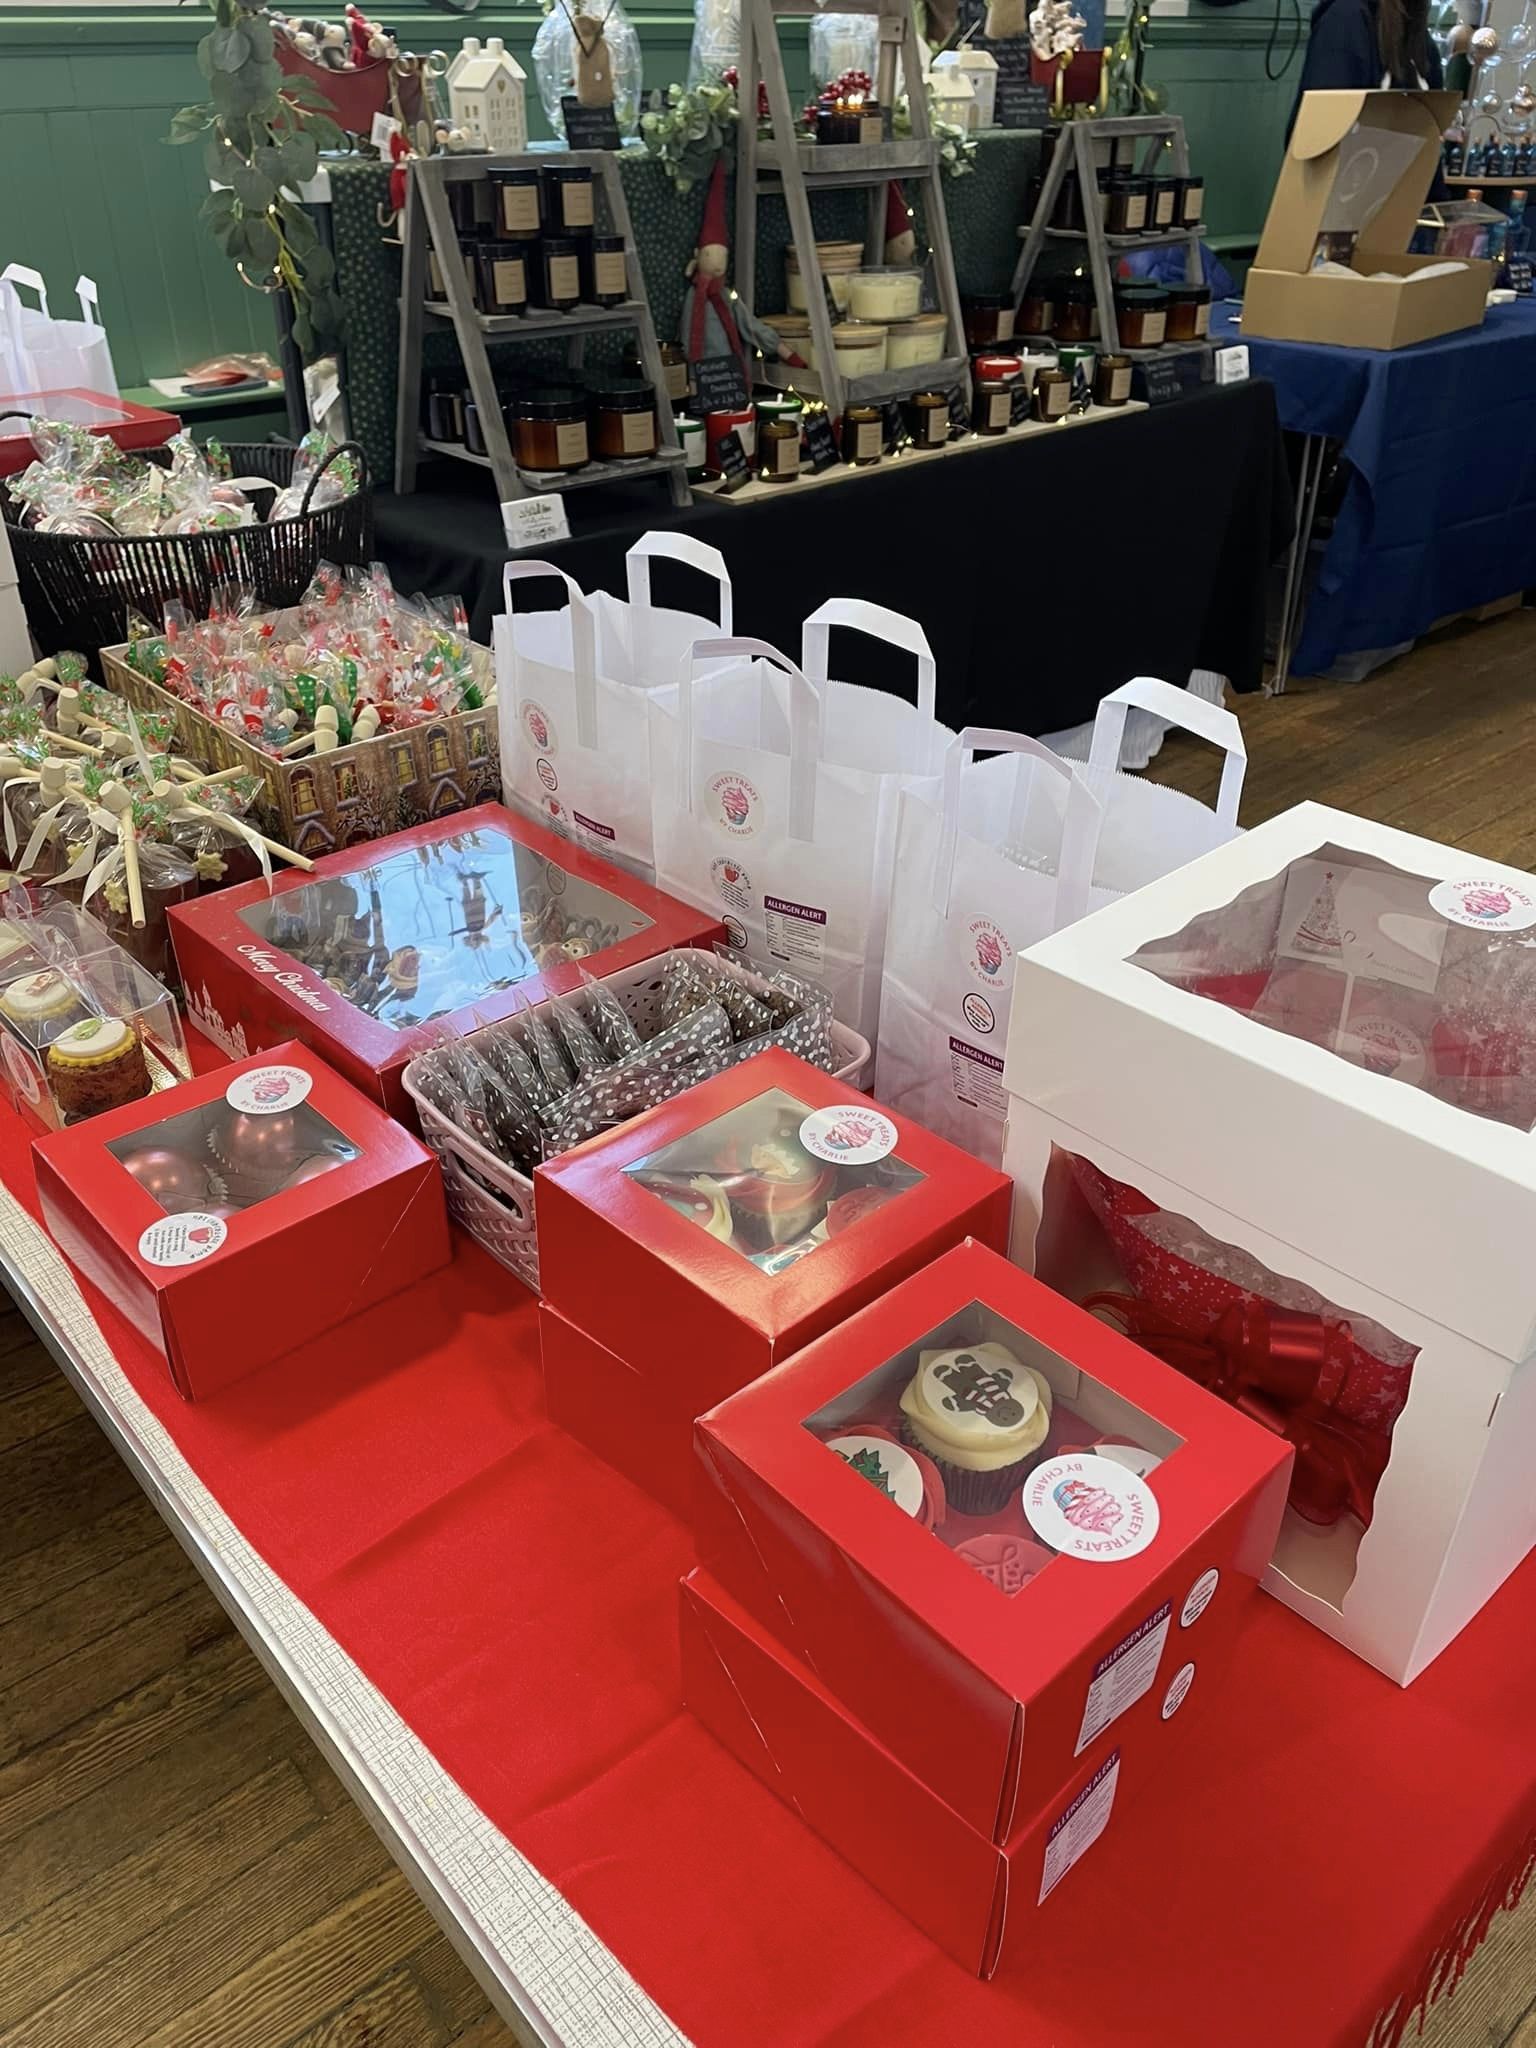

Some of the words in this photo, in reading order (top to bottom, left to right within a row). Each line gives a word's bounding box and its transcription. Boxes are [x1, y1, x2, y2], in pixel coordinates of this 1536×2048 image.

[711, 776, 733, 792] SWEET
[735, 777, 758, 801] TREATS
[1452, 880, 1496, 890] SWEET
[1499, 884, 1533, 907] TREATS
[767, 899, 801, 915] ALLERGEN
[801, 909, 823, 920] ALERT
[969, 920, 991, 933] SWEET
[991, 925, 1012, 957] TREATS
[236, 944, 280, 973] Merry
[274, 972, 332, 1012] Christmas
[952, 1040, 983, 1061] ALLERGEN
[245, 1070, 279, 1083] SWEET
[280, 1070, 306, 1085] TREATS
[837, 1111, 877, 1122] SWEET
[875, 1120, 891, 1147] TREATS
[812, 1141, 849, 1161] CHARLIE
[1066, 1463, 1083, 1473] BY
[1032, 1467, 1063, 1507] CHARLIE
[1127, 1493, 1145, 1537] SWEET
[1074, 1534, 1132, 1552] TREATS
[1097, 1626, 1143, 1676] ALLERGEN
[1142, 1602, 1170, 1634] ALERT
[1051, 1782, 1092, 1838] ALLERGEN
[1092, 1752, 1118, 1787] ALERT
